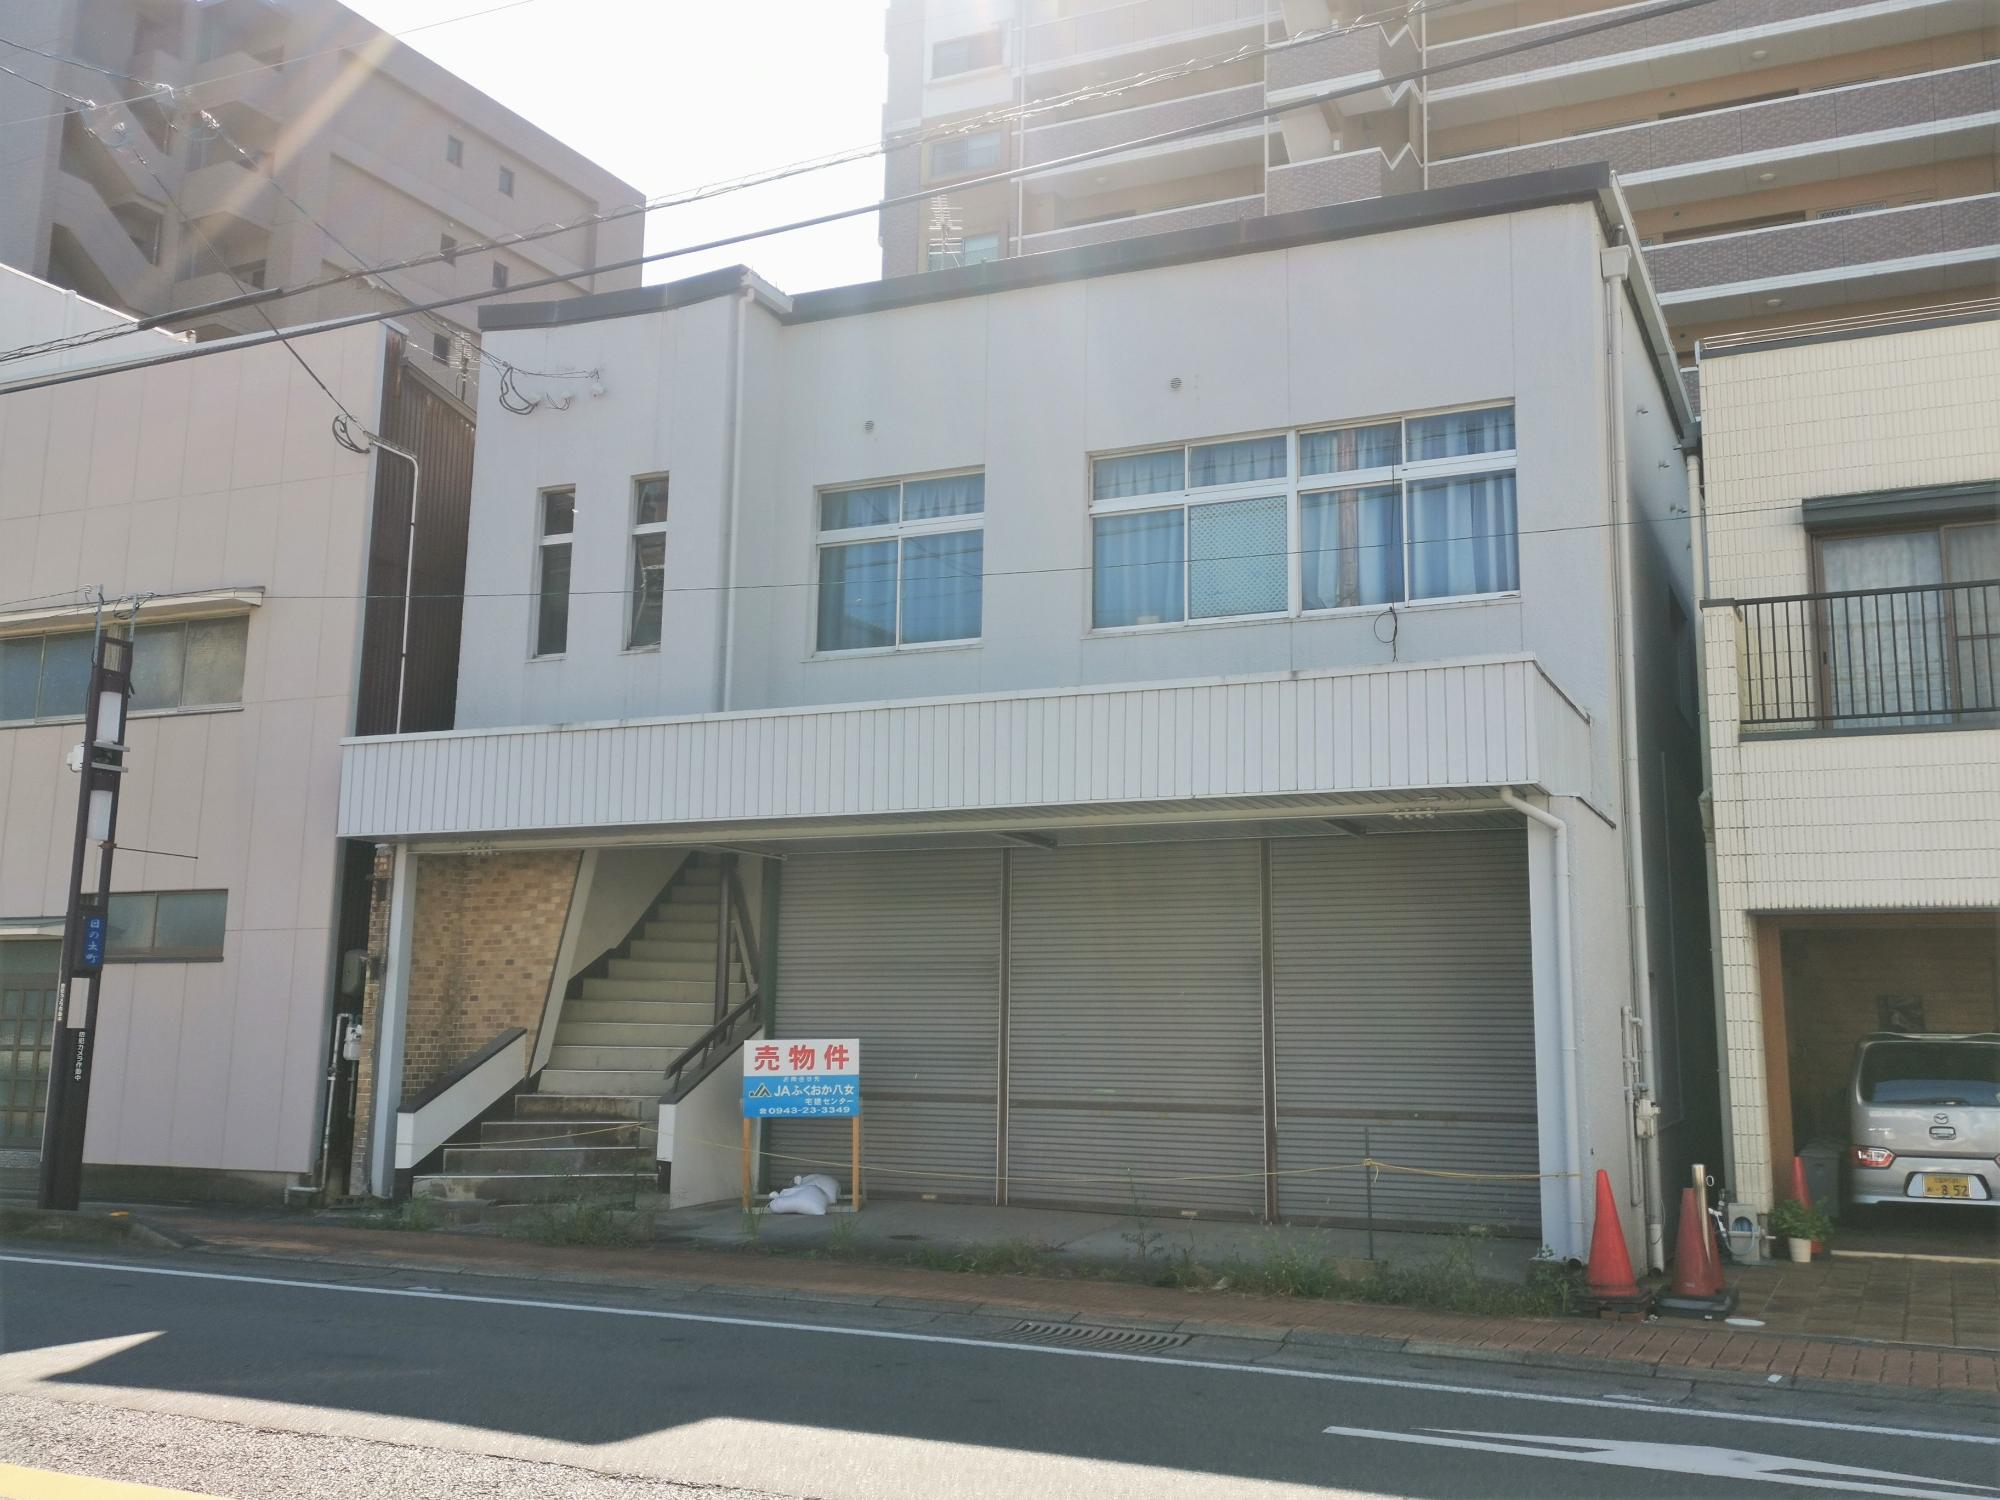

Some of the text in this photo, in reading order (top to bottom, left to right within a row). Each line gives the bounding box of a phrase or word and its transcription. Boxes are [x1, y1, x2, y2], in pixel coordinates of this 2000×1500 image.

[754, 1044, 850, 1071] 売物件
[768, 1107, 850, 1115] 0943-23-3349
